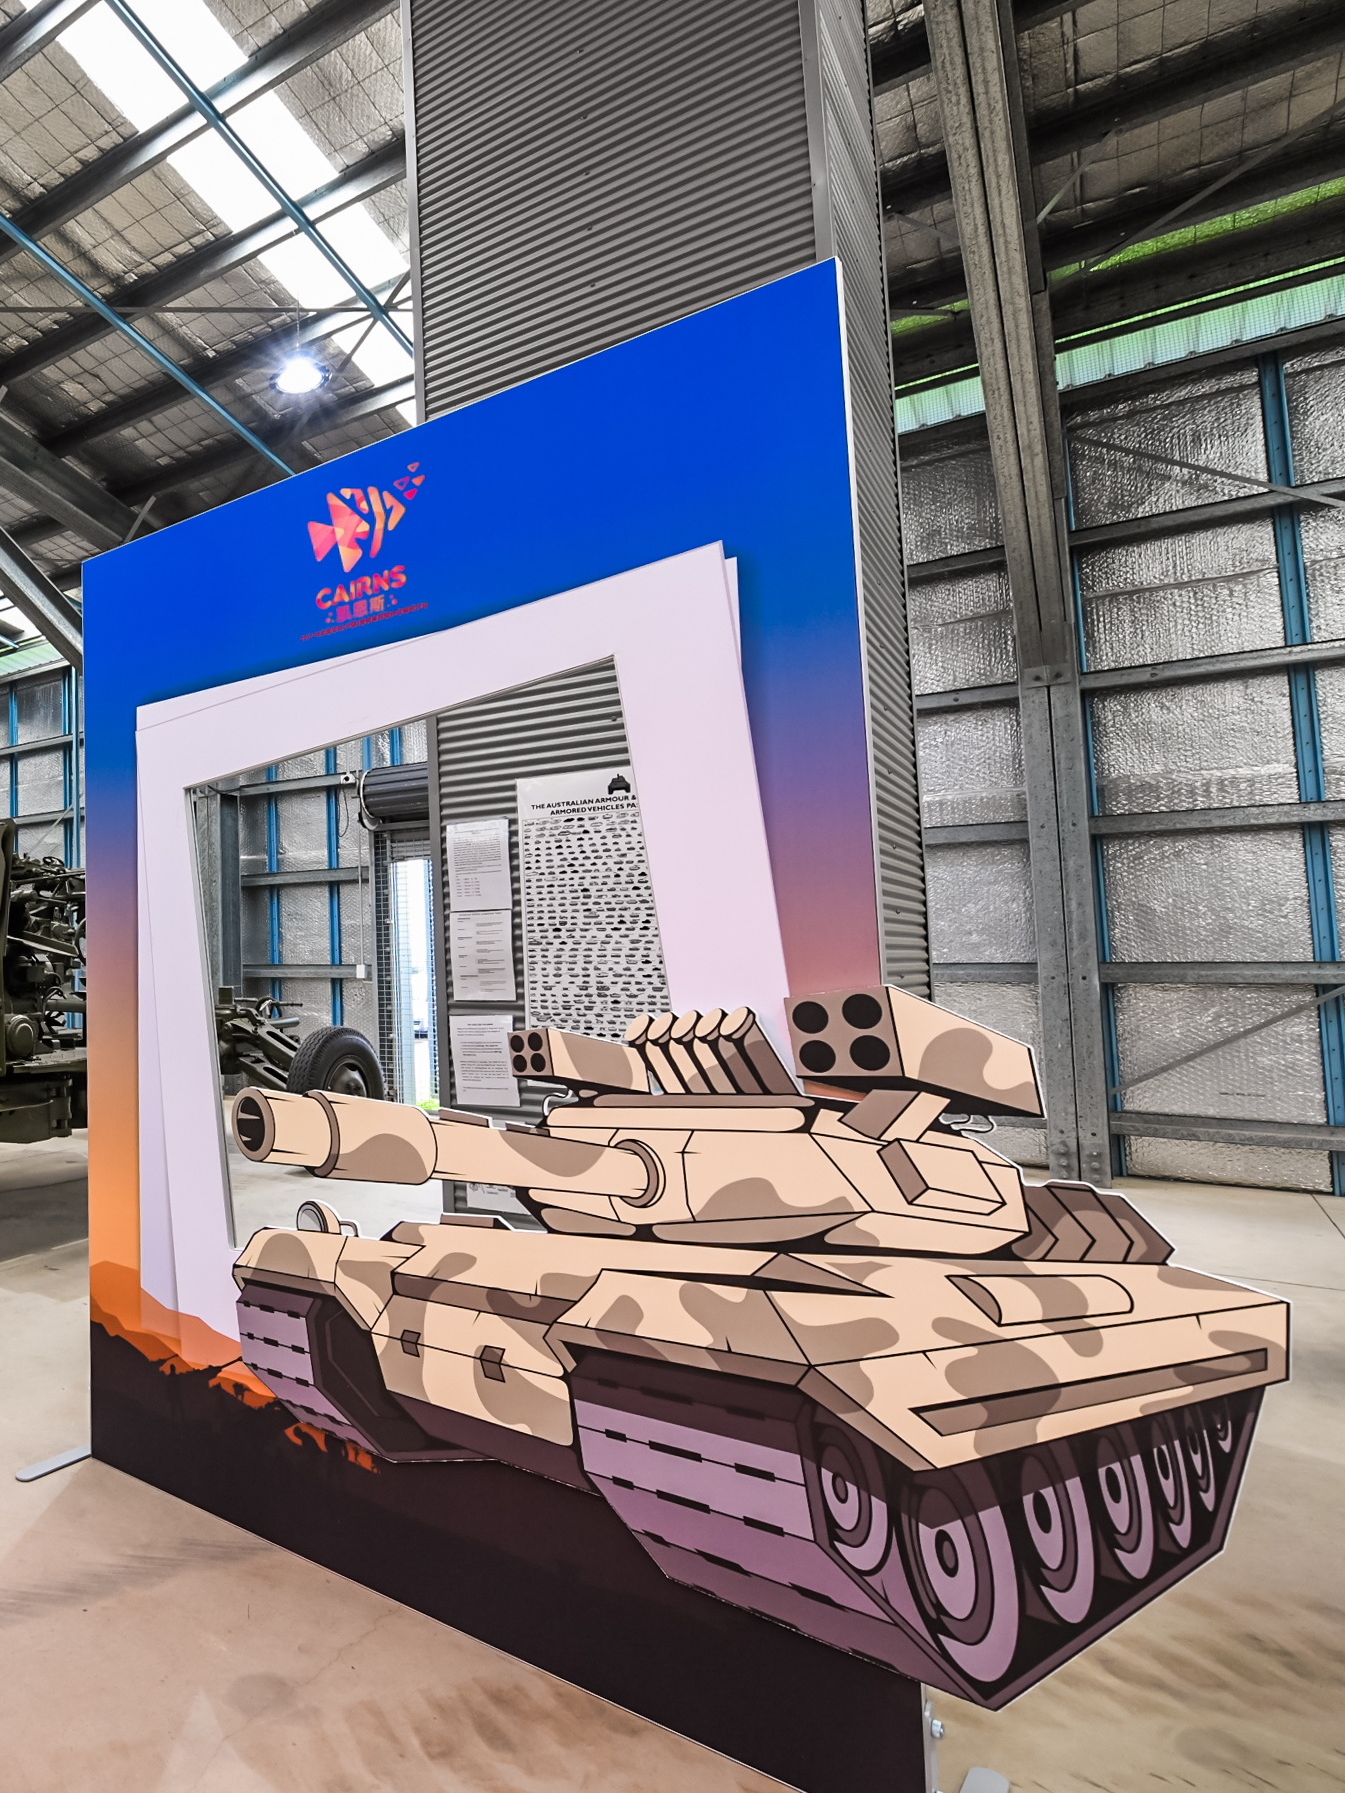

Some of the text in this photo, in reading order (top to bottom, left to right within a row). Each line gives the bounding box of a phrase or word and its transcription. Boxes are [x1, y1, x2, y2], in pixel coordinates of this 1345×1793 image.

[316, 565, 407, 610] CAIRNS
[546, 799, 594, 808] AUSTRALIAN
[595, 795, 630, 805] ARMOUR
[550, 807, 587, 816] ARMORED
[587, 804, 625, 812] VEHICLES
